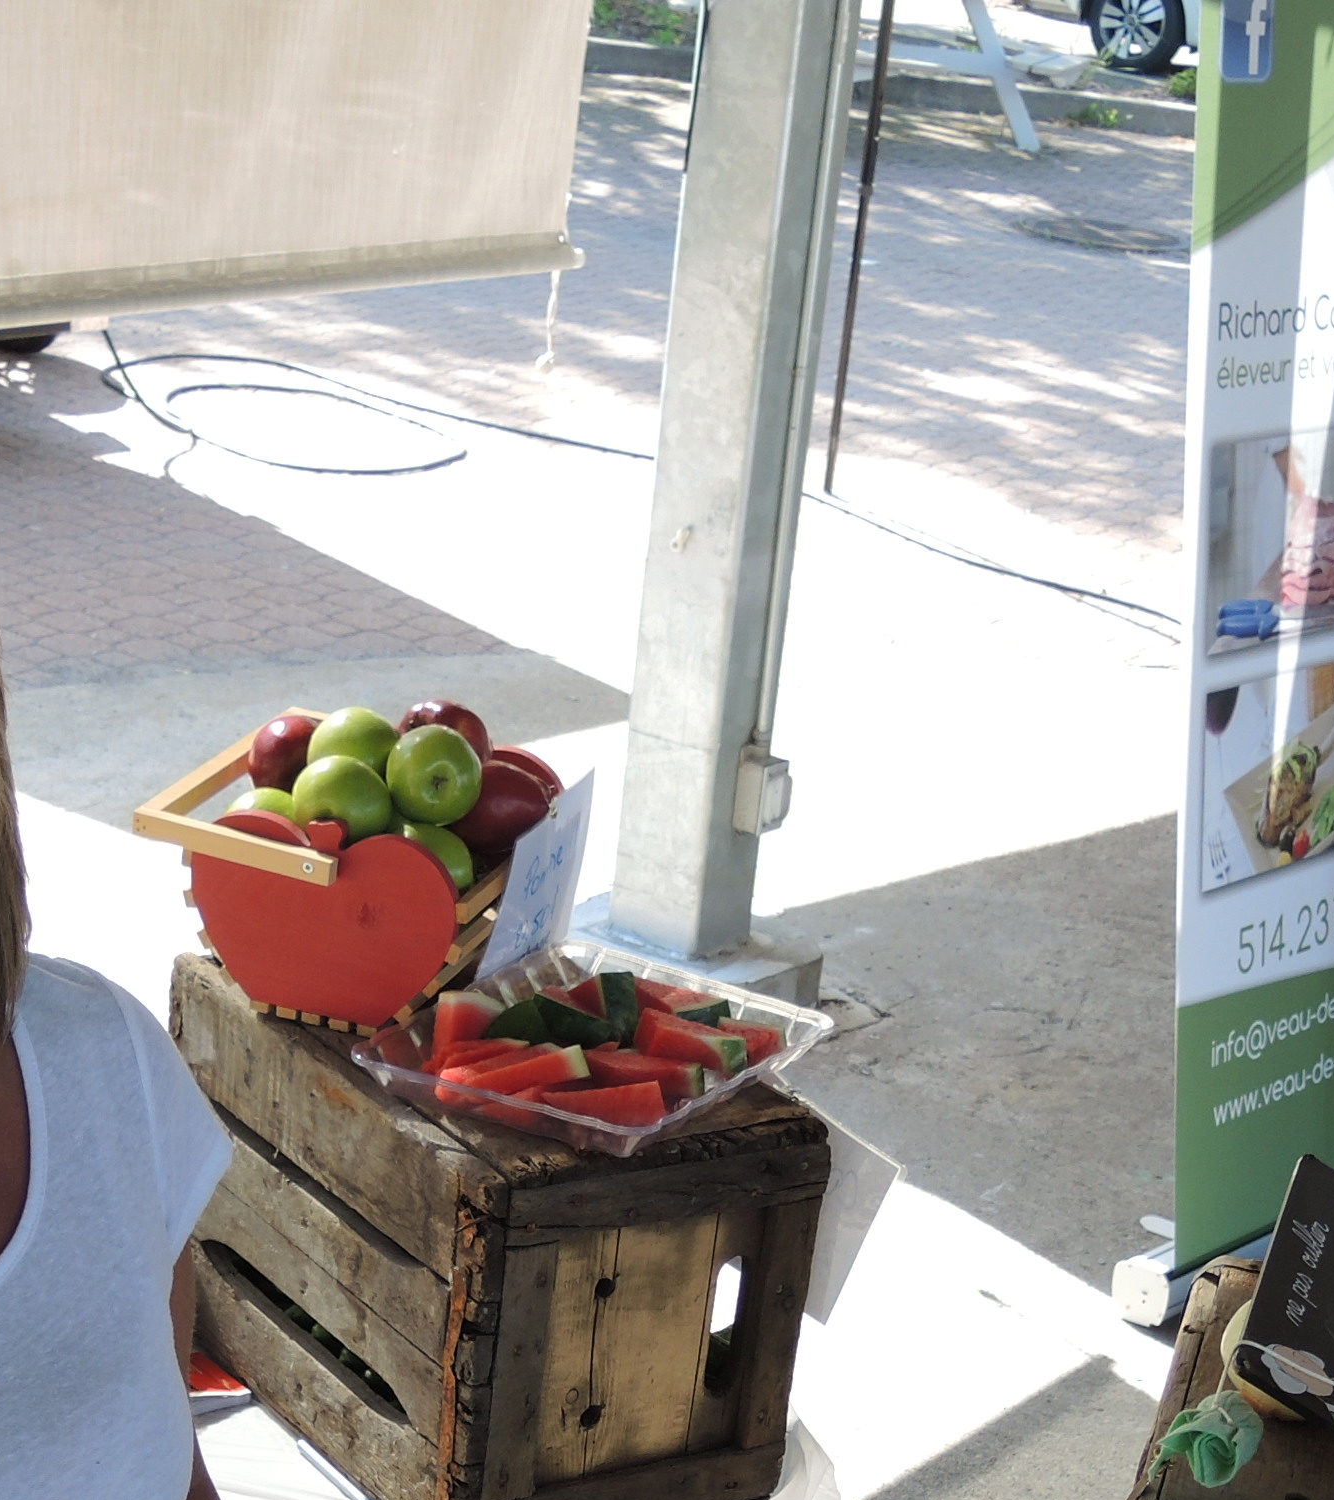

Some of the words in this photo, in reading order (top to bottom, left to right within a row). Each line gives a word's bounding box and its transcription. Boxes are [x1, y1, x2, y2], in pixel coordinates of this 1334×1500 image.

[1218, 297, 1307, 341] Richard
[1217, 357, 1291, 390] éleveur
[1298, 353, 1316, 380] et
[1291, 1219, 1330, 1269] oublier
[1291, 1273, 1317, 1309] pas
[1285, 1299, 1306, 1327] ne
